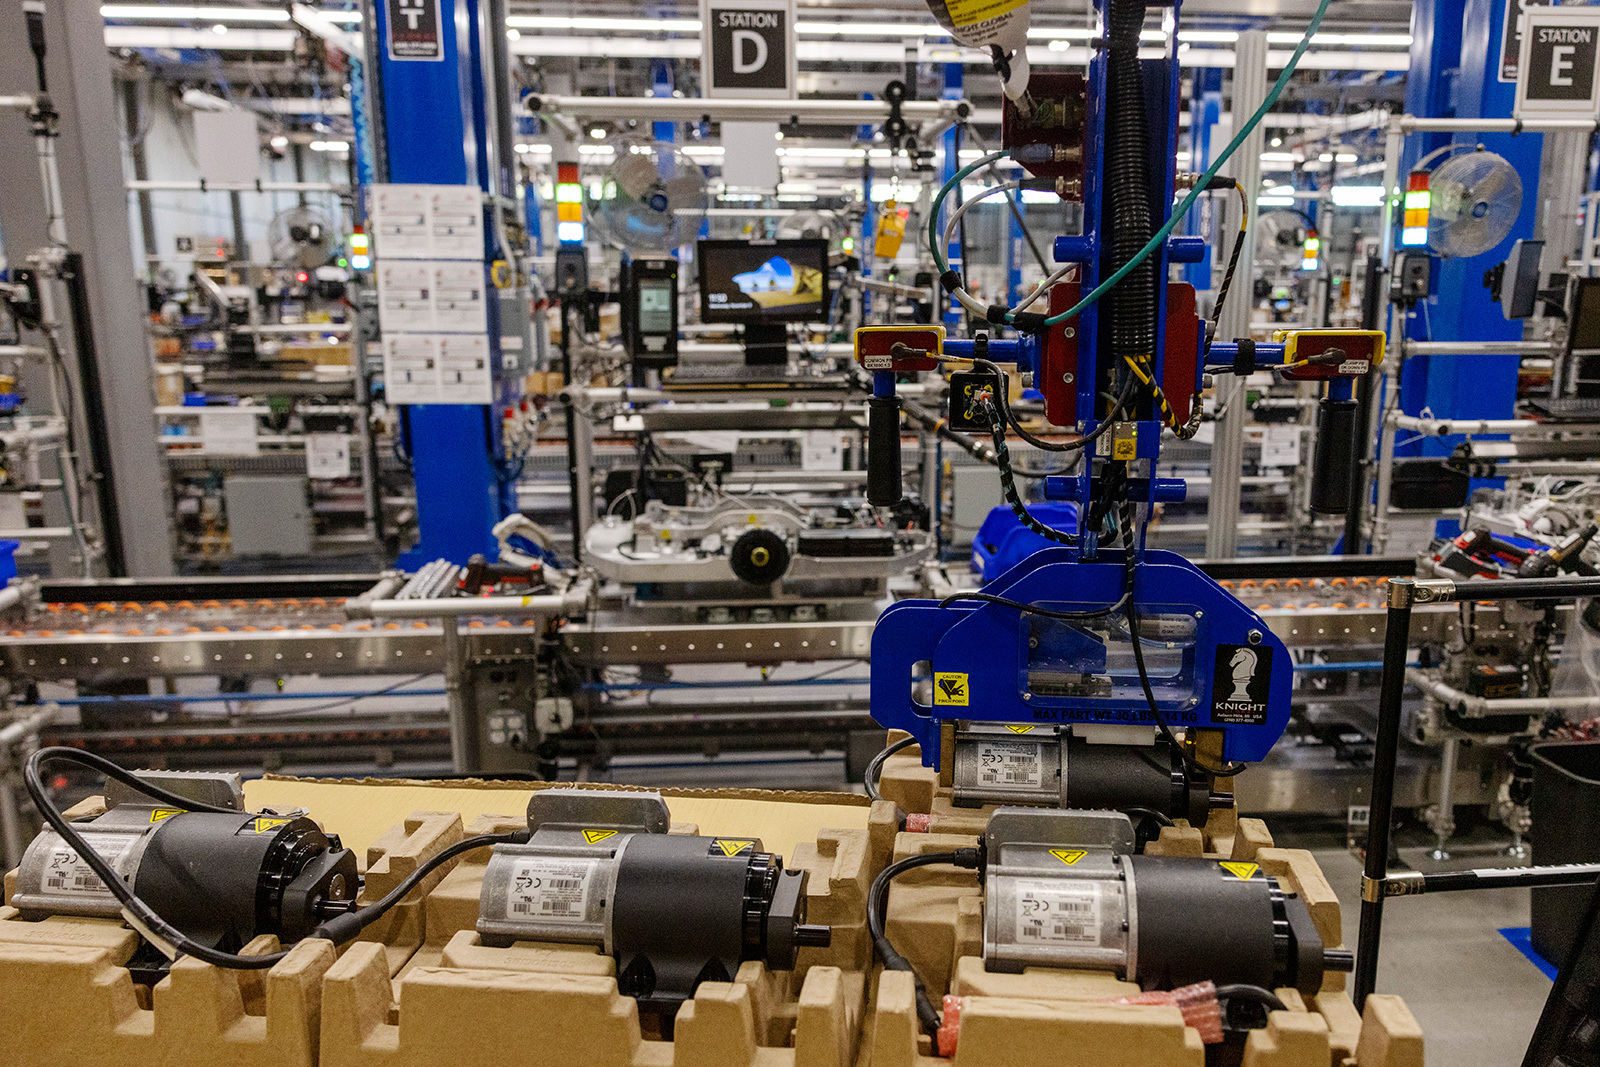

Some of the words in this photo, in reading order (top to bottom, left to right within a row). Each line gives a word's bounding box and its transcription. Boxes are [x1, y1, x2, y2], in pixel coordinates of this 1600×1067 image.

[719, 12, 778, 28] STATION
[1538, 29, 1591, 43] STATION
[732, 30, 768, 74] D
[1549, 45, 1575, 86] E
[1216, 702, 1266, 712] KNIGHT
[1033, 710, 1058, 720] MAX
[1061, 710, 1090, 720] PART
[1094, 710, 1112, 720] WT
[1115, 711, 1129, 721] 30
[1181, 712, 1198, 722] KG
